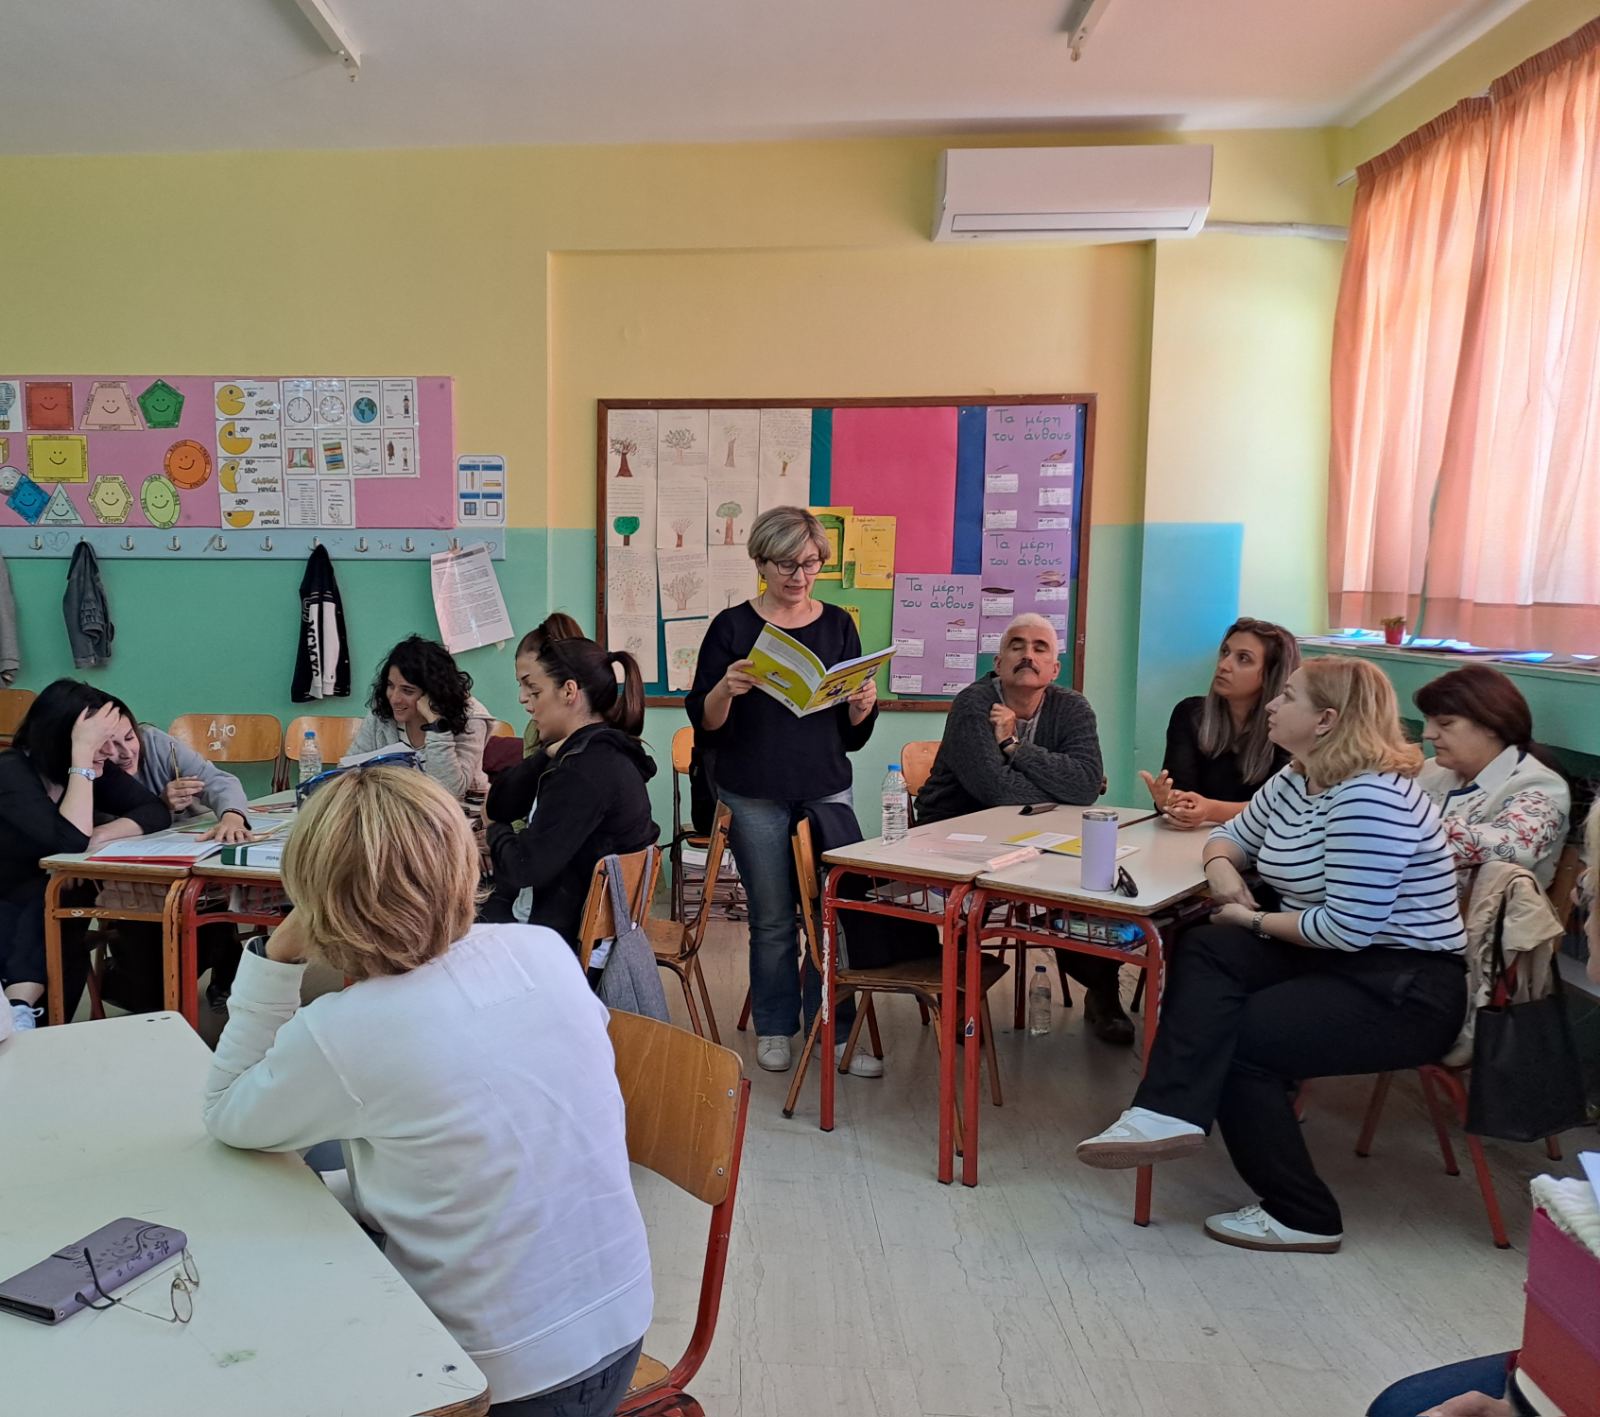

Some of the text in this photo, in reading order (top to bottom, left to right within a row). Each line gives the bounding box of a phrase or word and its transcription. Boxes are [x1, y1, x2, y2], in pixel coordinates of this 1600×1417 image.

[995, 408, 1061, 427] Τα μέρη
[993, 427, 1072, 441] του άνθους
[990, 533, 1054, 554] Τα μέρη
[989, 554, 1063, 566] του άνθους
[905, 577, 964, 596] Τα μέρη
[900, 599, 922, 608] του
[930, 596, 975, 609] άνθους
